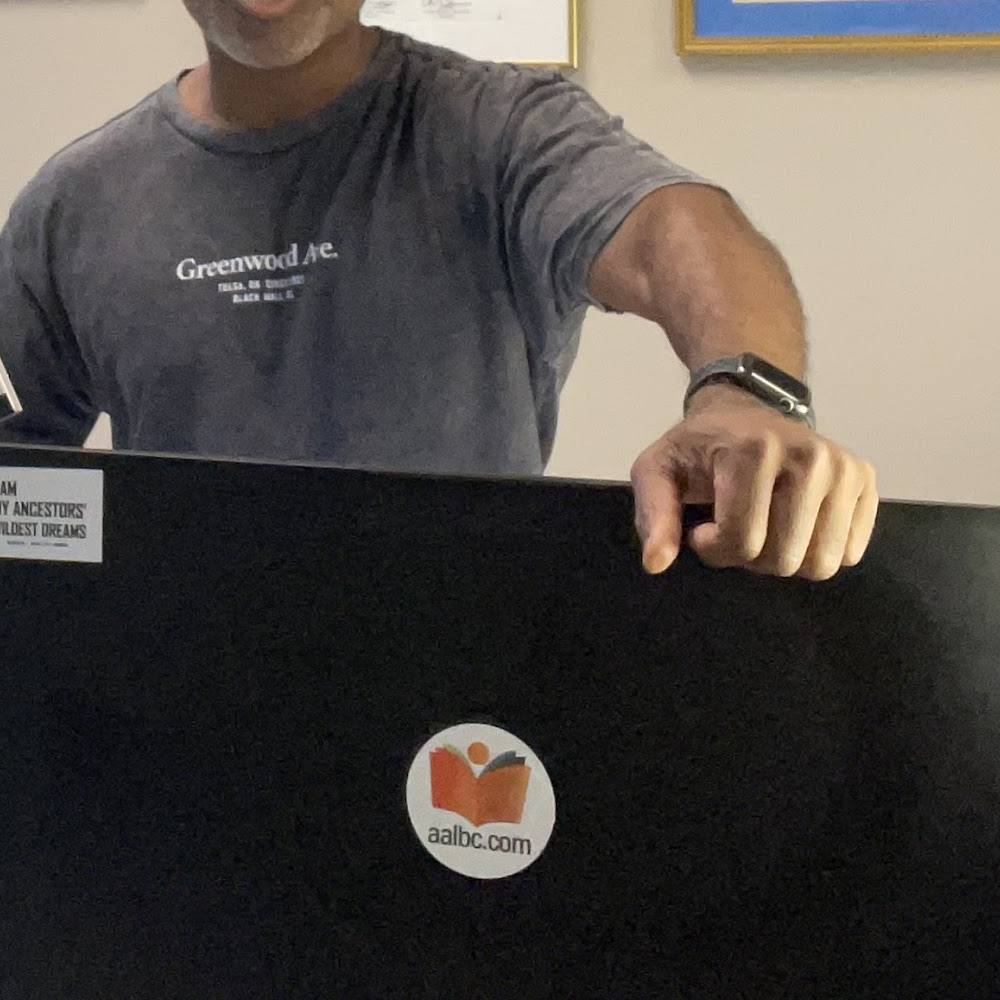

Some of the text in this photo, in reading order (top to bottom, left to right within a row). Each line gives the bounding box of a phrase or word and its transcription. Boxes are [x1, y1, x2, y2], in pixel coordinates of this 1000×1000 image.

[176, 242, 339, 280] Greenwood Ae.
[0, 480, 17, 496] AM
[41, 522, 87, 539] DREAMS
[427, 825, 532, 855] aalbc.com
